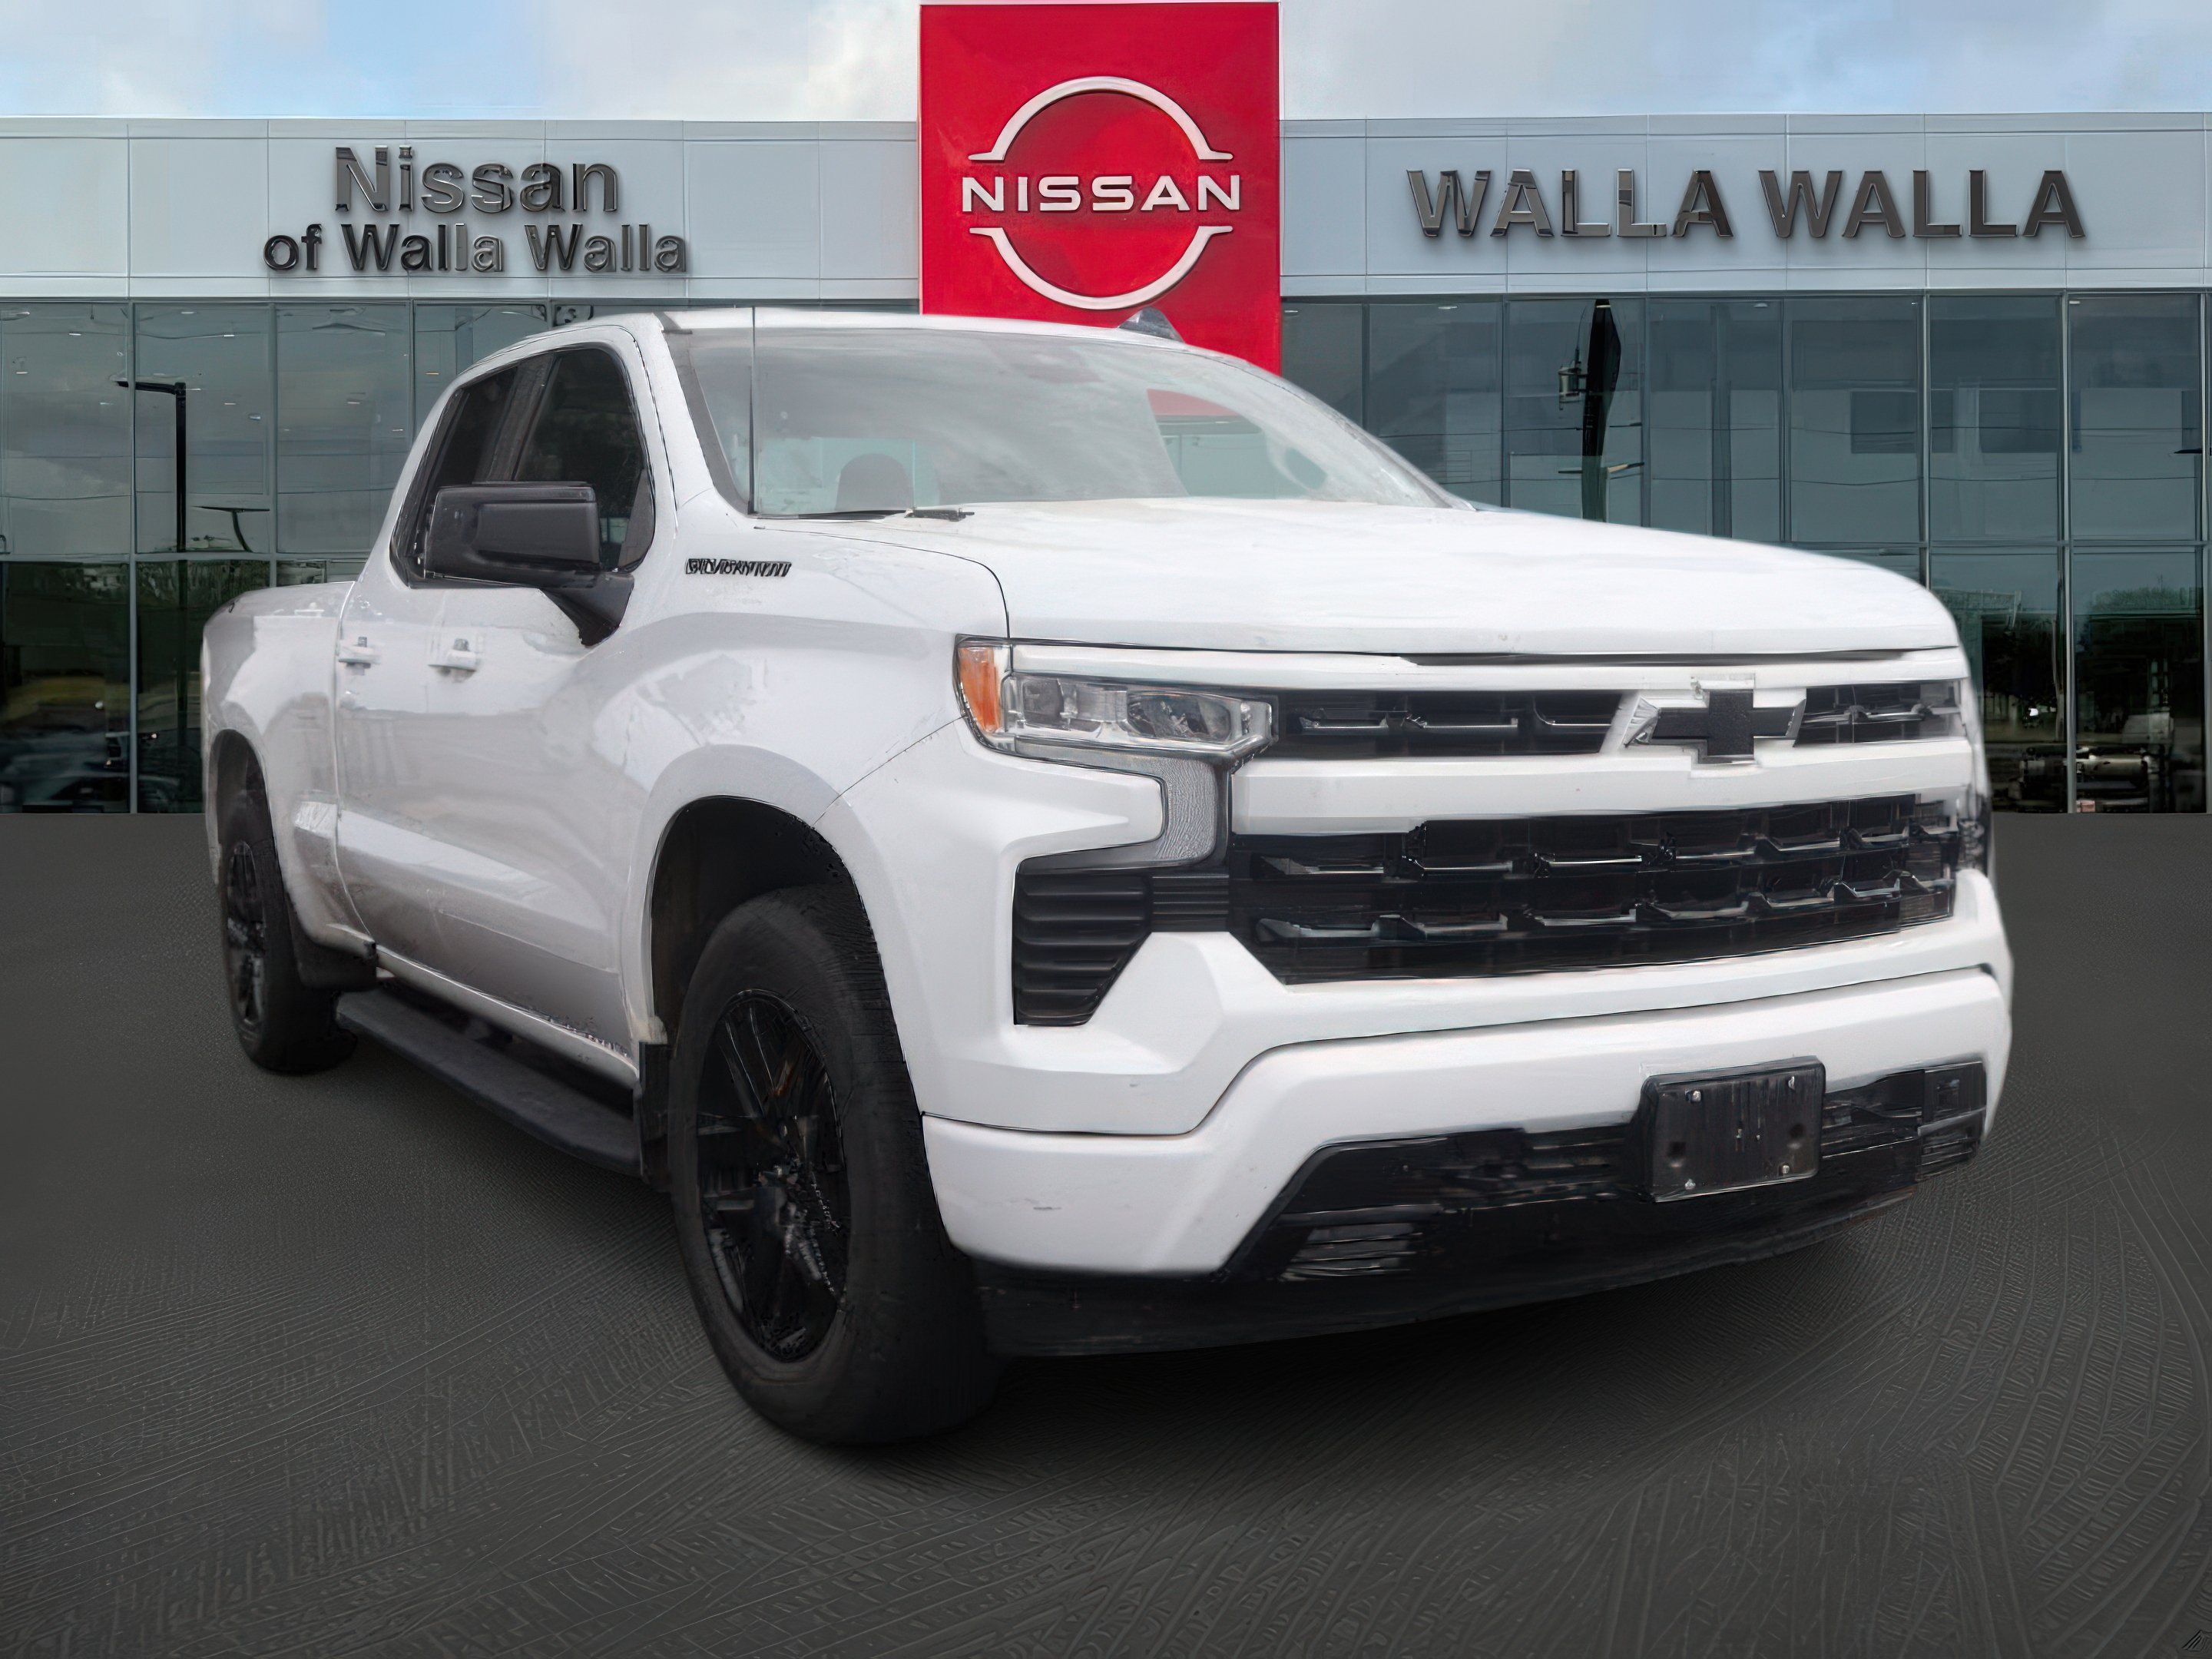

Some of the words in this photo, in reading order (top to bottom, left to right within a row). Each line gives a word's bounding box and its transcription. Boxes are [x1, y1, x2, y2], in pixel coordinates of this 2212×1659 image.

[335, 144, 619, 213] Nissan
[962, 174, 1240, 212] NISSAN
[1406, 168, 1734, 239] WALLA
[1757, 169, 2086, 239] WALLA
[263, 223, 323, 271] of
[341, 223, 505, 272] Walla
[525, 223, 687, 272] Walla
